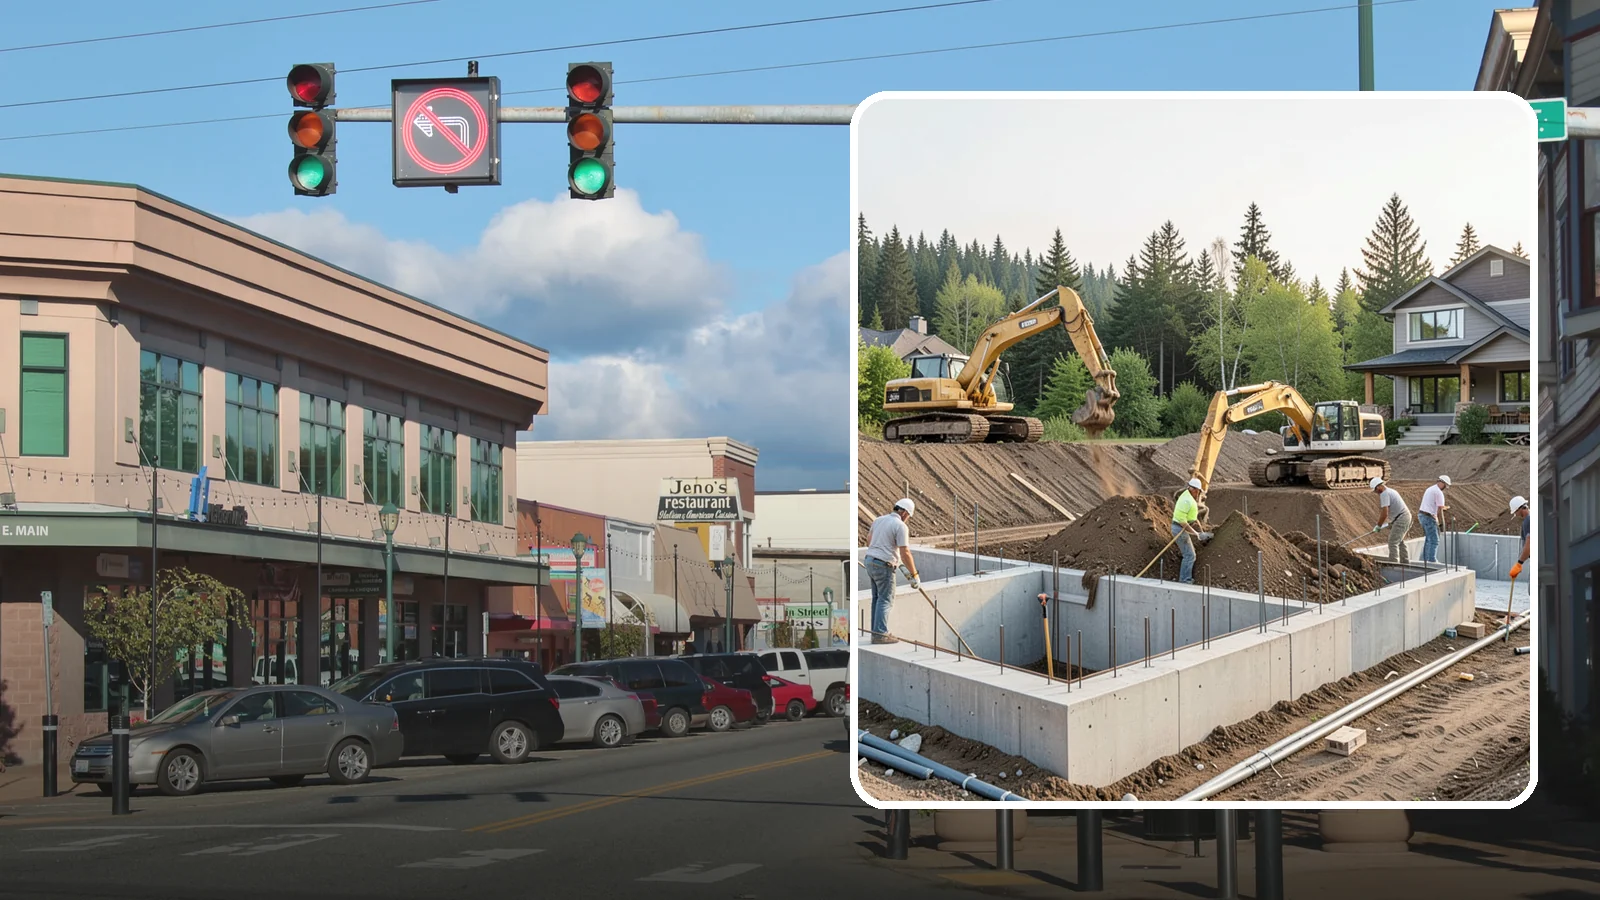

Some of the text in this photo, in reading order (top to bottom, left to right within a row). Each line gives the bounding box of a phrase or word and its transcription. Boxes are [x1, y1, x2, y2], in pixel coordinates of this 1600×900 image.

[670, 480, 727, 494] Jeno's
[665, 496, 731, 509] restaurant
[659, 510, 681, 519] Italian
[686, 509, 714, 519] American
[715, 509, 737, 519] Cuisine
[2, 525, 49, 536] E. MAIN
[797, 607, 828, 616] Street
